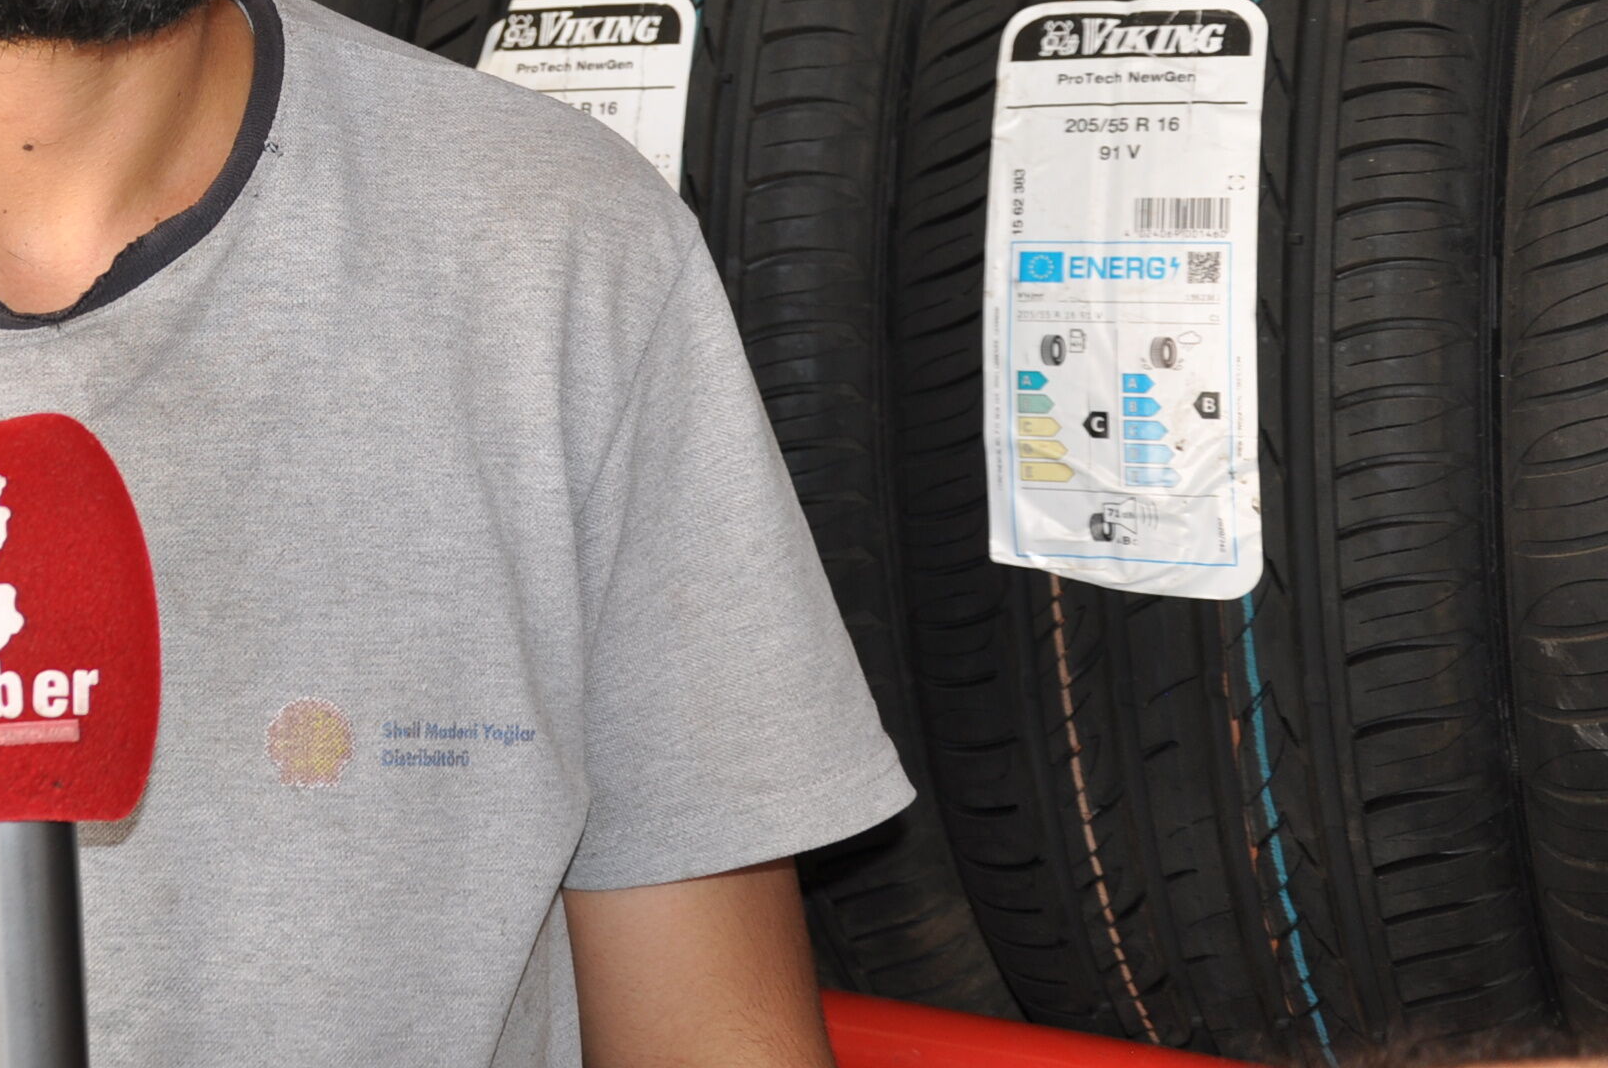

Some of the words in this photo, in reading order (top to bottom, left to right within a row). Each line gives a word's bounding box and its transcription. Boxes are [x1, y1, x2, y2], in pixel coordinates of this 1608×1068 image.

[539, 11, 663, 47] VIKING
[1081, 17, 1226, 56] VIKING
[516, 62, 572, 74] ProTech
[576, 59, 634, 72] NewGen
[1057, 72, 1122, 85] ProTech
[1128, 71, 1196, 84] NewGen
[599, 101, 618, 115] 16
[1064, 117, 1129, 134] 205/55
[1136, 117, 1150, 132] R
[1158, 117, 1180, 132] 16
[1099, 145, 1121, 161] 91
[1128, 144, 1141, 160] V
[1069, 256, 1166, 280] ENERG
[1201, 397, 1217, 413] B
[1090, 416, 1106, 433] C
[380, 721, 421, 740] Shell
[424, 722, 479, 740] Madeni
